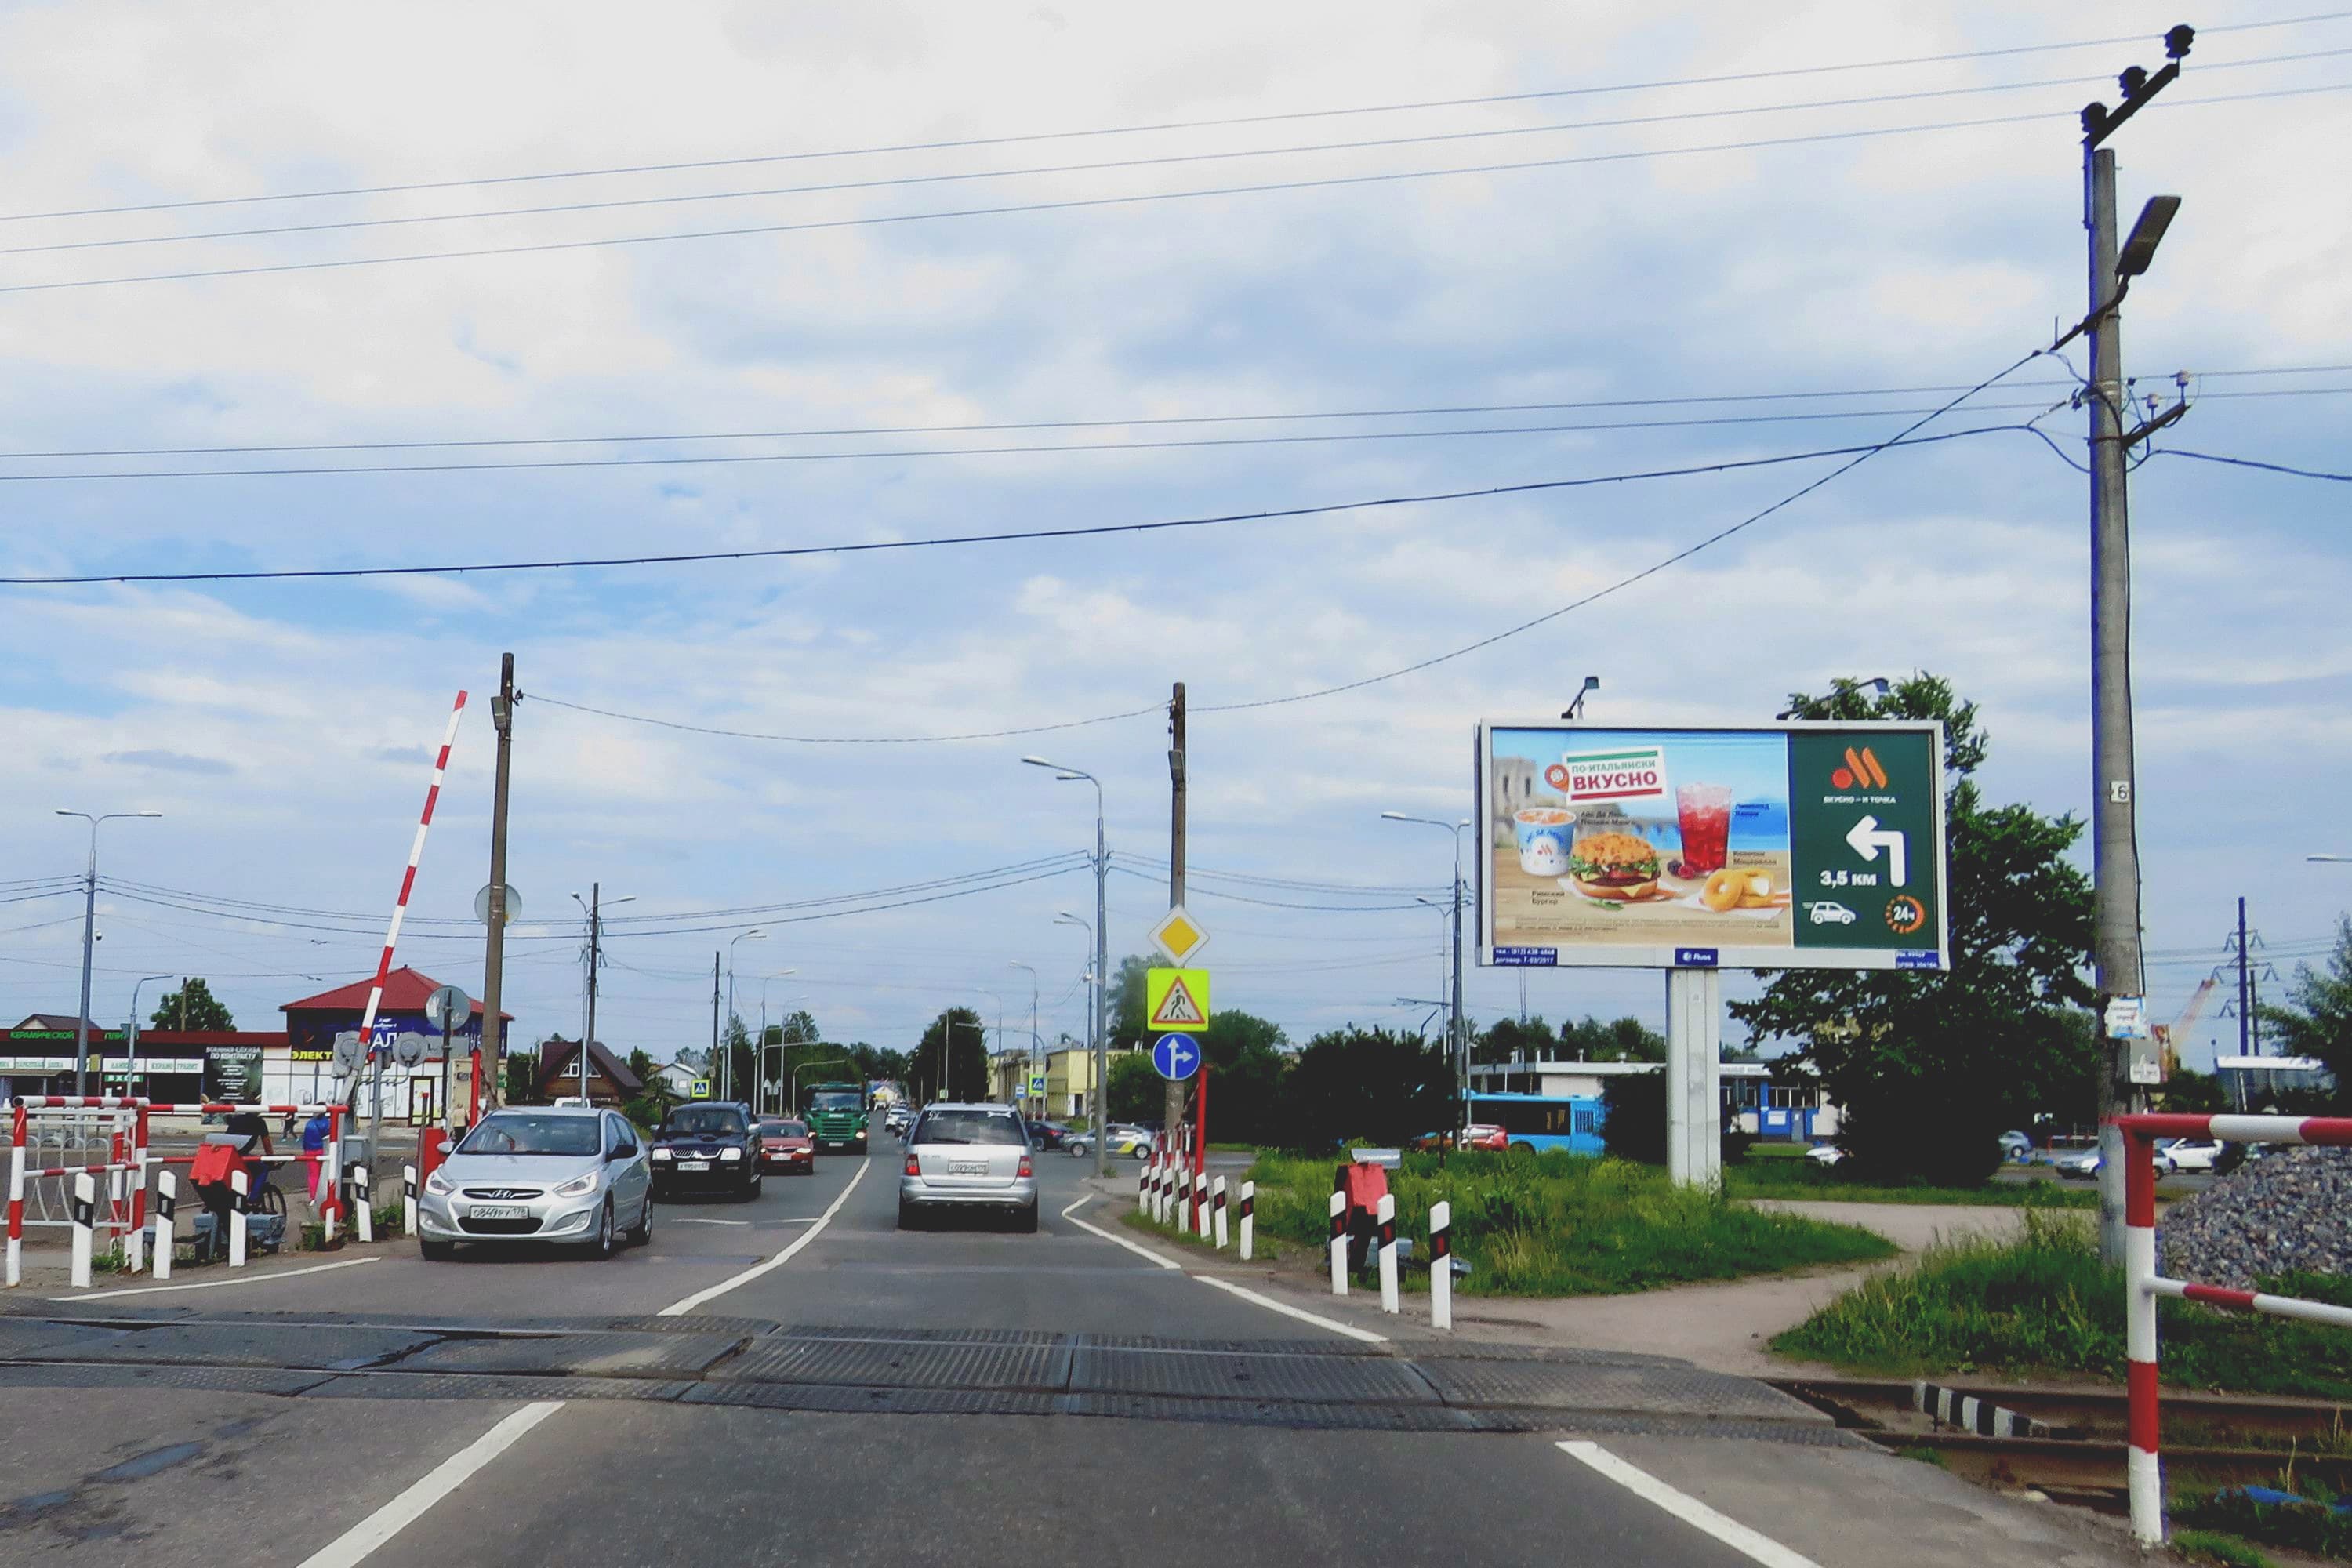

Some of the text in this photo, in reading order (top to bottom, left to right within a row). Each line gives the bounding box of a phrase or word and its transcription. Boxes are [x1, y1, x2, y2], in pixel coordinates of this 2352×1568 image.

[1572, 760, 1656, 773] ПО-ИТАЛЬЯНСКИ
[1573, 771, 1657, 791] ВКУСНО
[1820, 870, 1849, 889] 3,5
[10, 1030, 75, 1040] КЕРАМИЧЕСКОЙ
